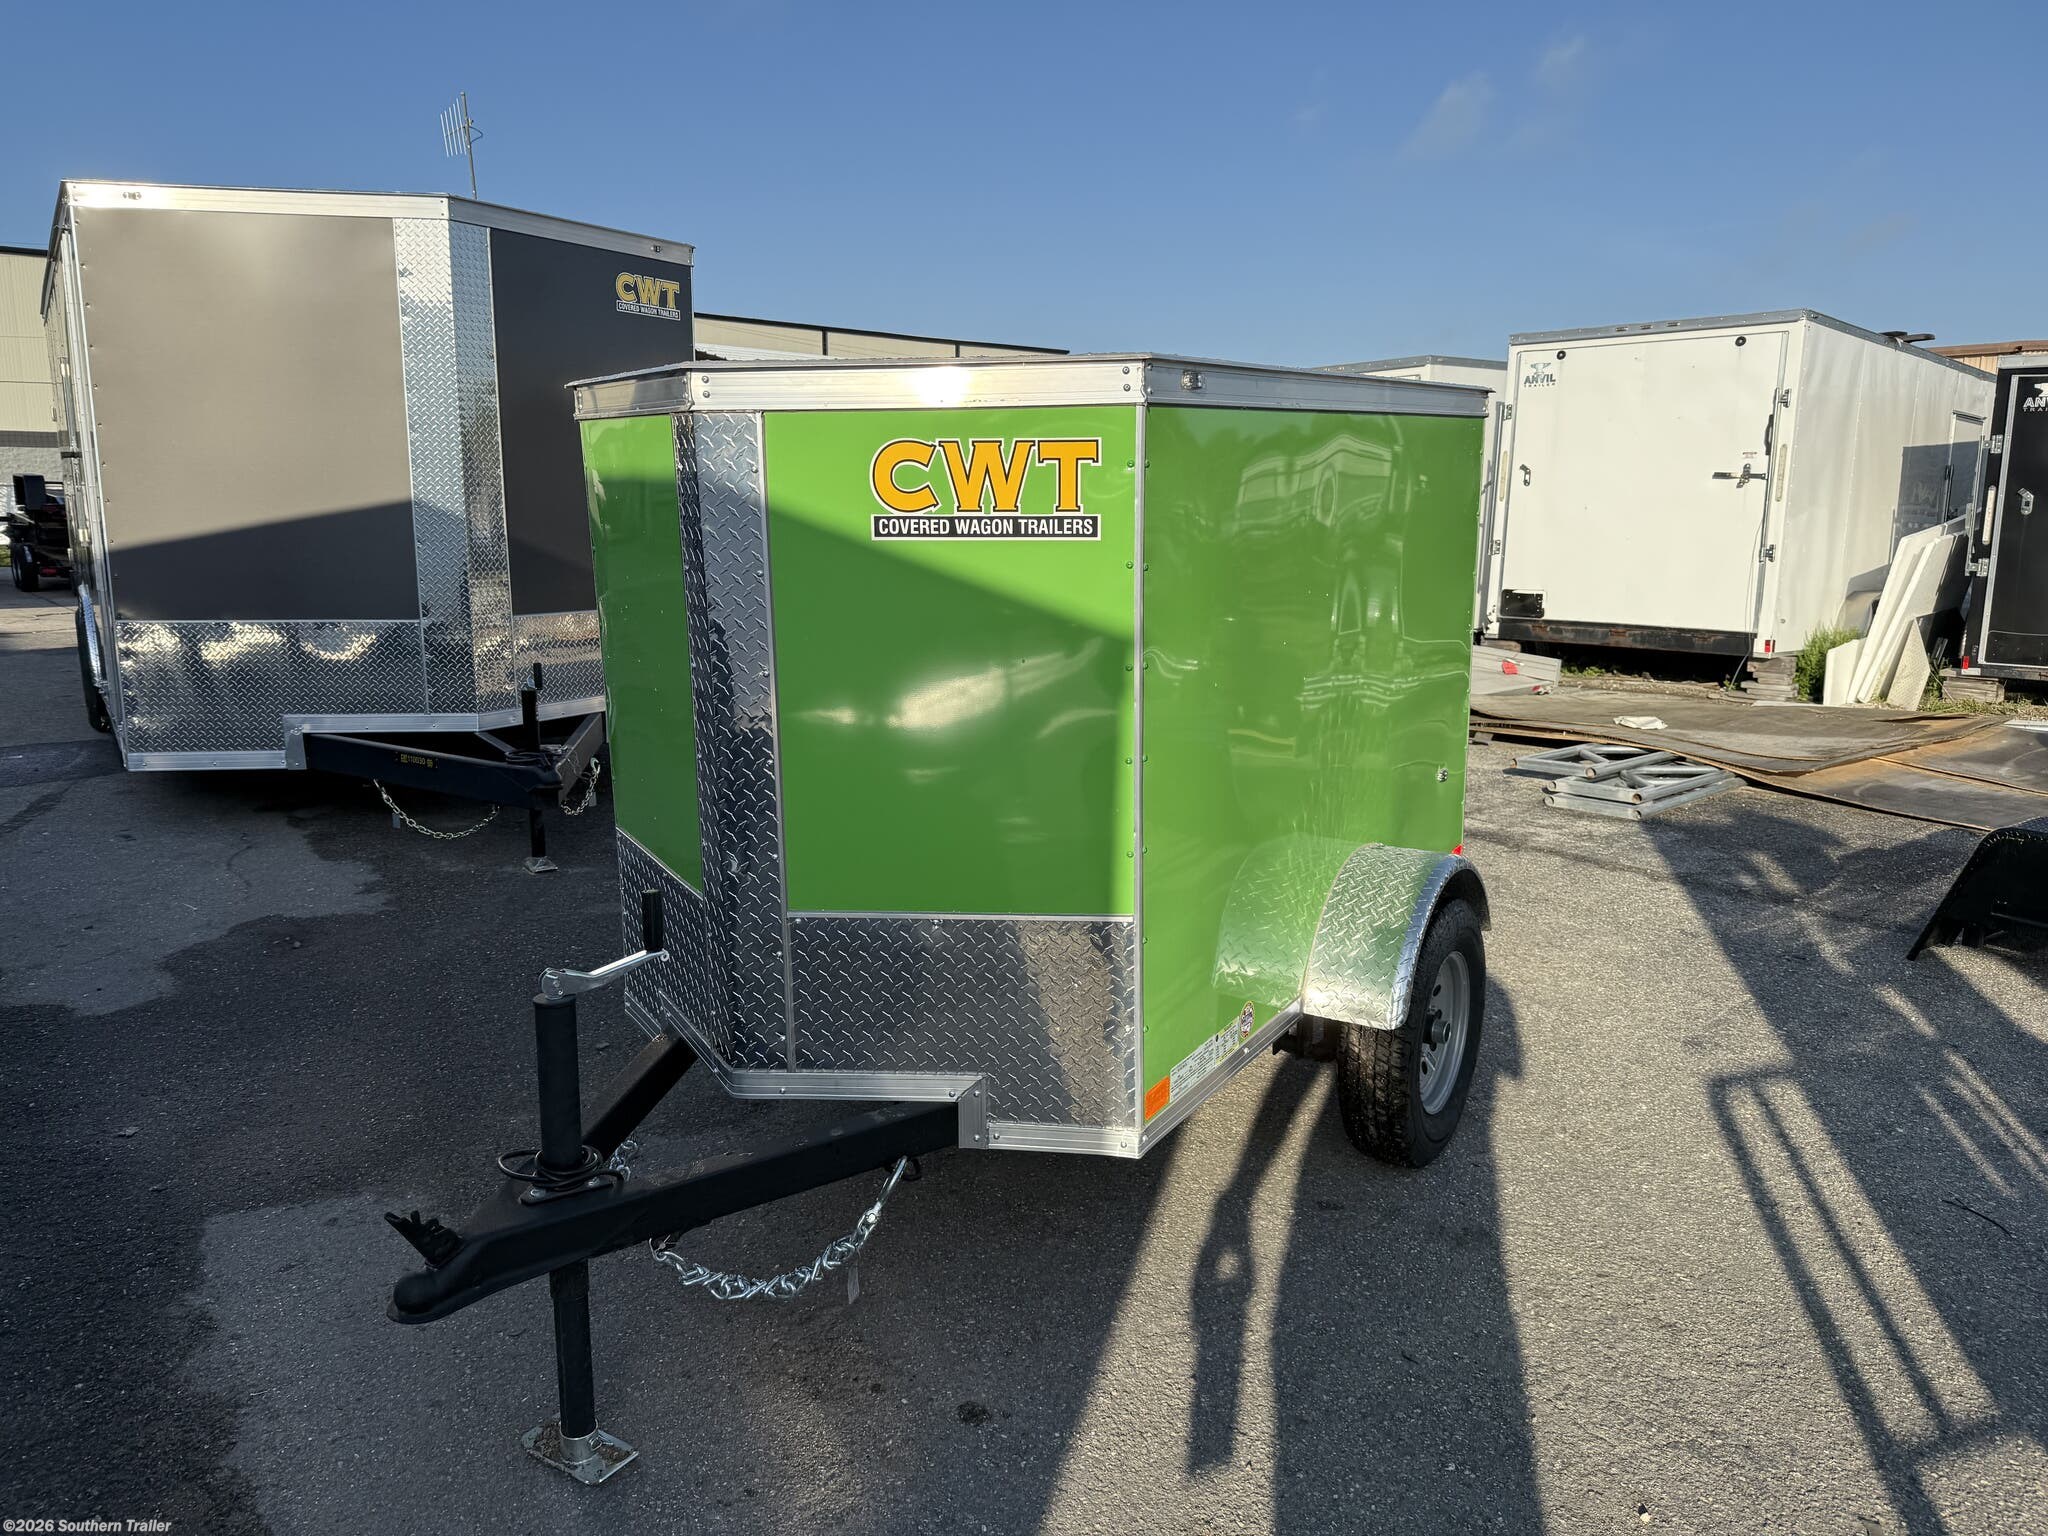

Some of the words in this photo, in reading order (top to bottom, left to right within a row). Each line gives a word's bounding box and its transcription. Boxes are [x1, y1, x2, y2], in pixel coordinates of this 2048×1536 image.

[616, 272, 680, 310] CWT
[619, 303, 640, 312] COVERED
[641, 306, 658, 315] WAGON
[658, 309, 679, 319] TRAILERS
[1524, 374, 1556, 385] ANVIL
[2023, 397, 2048, 408] AN
[871, 438, 1101, 514] CWT
[878, 518, 949, 536] COVERED
[955, 518, 1013, 536] WAGON
[1018, 518, 1093, 536] TRAILERS
